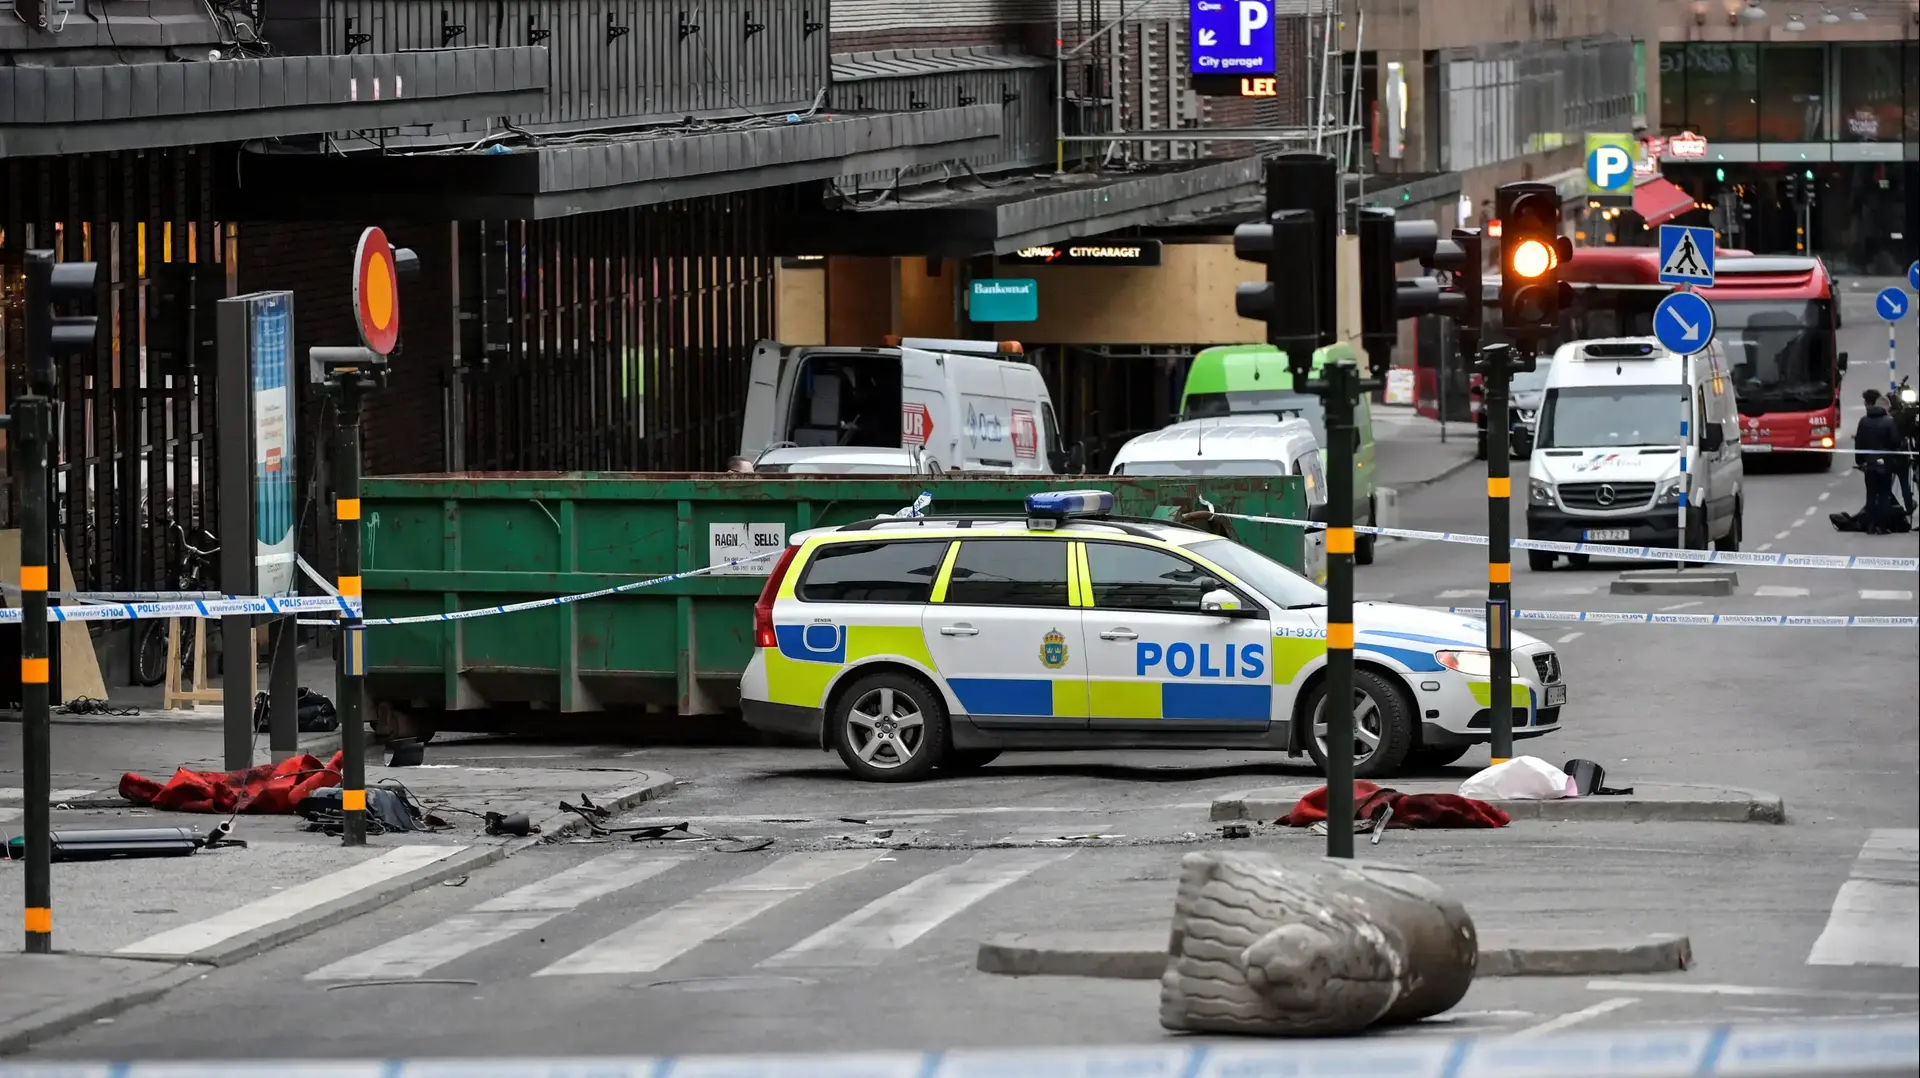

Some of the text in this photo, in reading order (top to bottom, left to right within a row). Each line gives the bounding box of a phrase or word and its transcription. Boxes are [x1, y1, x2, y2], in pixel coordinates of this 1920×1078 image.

[1240, 0, 1268, 46] P
[1198, 56, 1263, 68] City garaget
[1596, 147, 1629, 187] P
[1069, 247, 1141, 258] CITYGARAGET
[974, 282, 1029, 294] Bankomat
[903, 412, 924, 436] UR
[1809, 417, 1827, 425] 4811
[715, 533, 779, 547] RAGN SELLS
[137, 603, 160, 613] POLIS
[243, 603, 266, 612] POLIS
[279, 599, 302, 608] POLIS
[0, 609, 17, 618] OLIS
[101, 608, 124, 617] POLIS
[1275, 626, 1328, 638] 31-9370
[1136, 642, 1265, 679] POLIS
